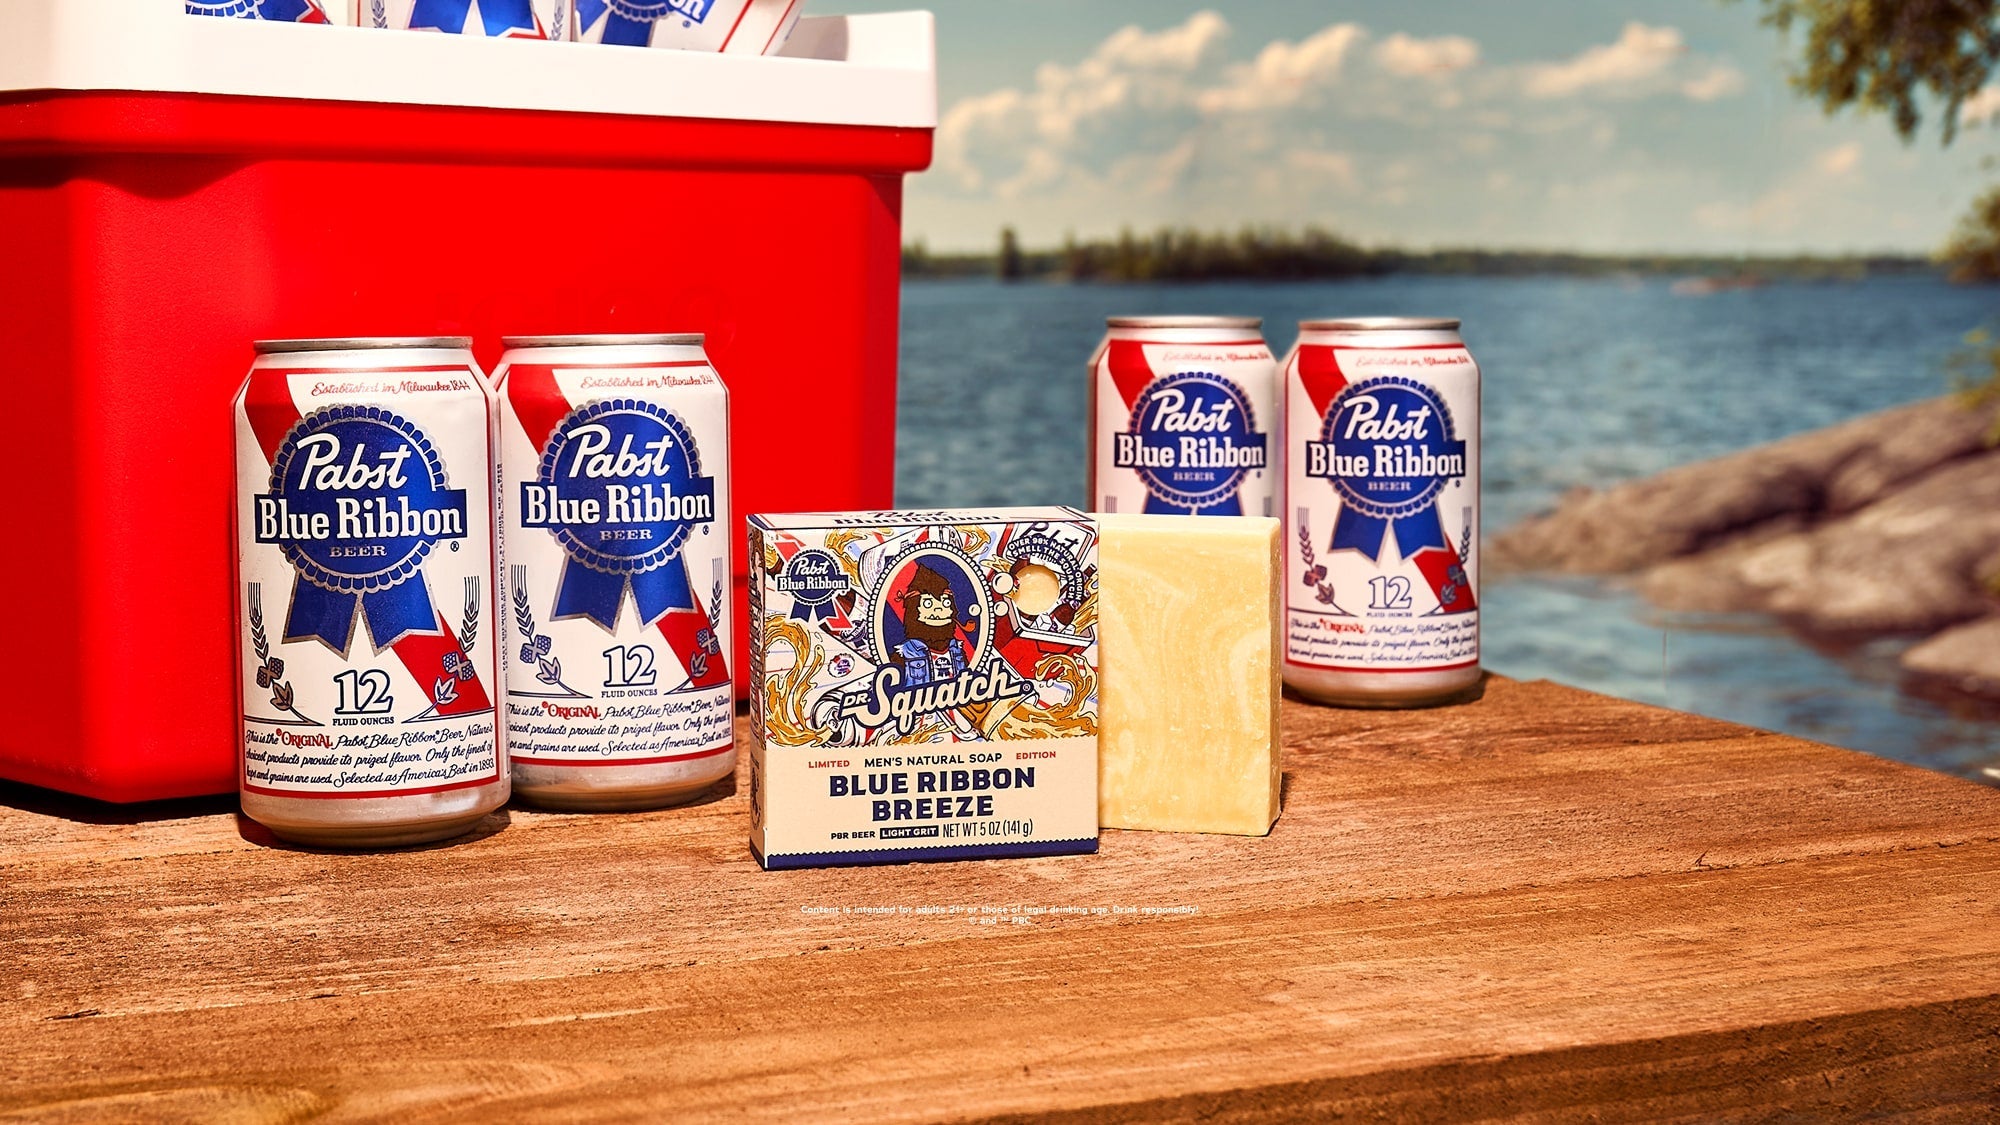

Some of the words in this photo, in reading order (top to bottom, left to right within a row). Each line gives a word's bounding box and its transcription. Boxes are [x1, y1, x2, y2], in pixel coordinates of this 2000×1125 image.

[312, 382, 378, 396] Established
[382, 382, 395, 394] in
[395, 380, 450, 394] Milwaukee
[450, 380, 471, 391] 1844
[580, 377, 644, 388] Established
[646, 378, 659, 388] in
[1150, 388, 1235, 432] Pabst
[1343, 395, 1431, 440] Pabst
[296, 432, 412, 491] Pabst
[566, 423, 674, 479] Pabst
[1117, 434, 1175, 468] Blue
[1178, 436, 1264, 468] Ribbon
[1309, 443, 1370, 477] Blue
[1373, 444, 1464, 478] Ribbon
[525, 484, 600, 524] Blue
[606, 483, 712, 524] Ribbon
[258, 497, 330, 540] Blue
[336, 496, 463, 540] Ribbon
[600, 529, 653, 541] BEER
[330, 545, 388, 558] BEER
[795, 557, 830, 576] Pabst
[1008, 537, 1030, 551] OVER
[1075, 571, 1084, 601] ORIGIN
[1013, 545, 1042, 557] SMELL
[1044, 547, 1062, 560] THE
[1060, 559, 1074, 600] SQUATCH
[779, 578, 806, 591] Blue
[806, 576, 847, 590] Ribbon
[1368, 576, 1413, 610] 12
[602, 644, 657, 688] 12
[333, 668, 394, 716] 12
[601, 690, 626, 698] FLUID
[627, 688, 658, 698] OUNCES
[842, 692, 872, 708] DR.
[333, 718, 358, 726] FLUID
[360, 716, 394, 726] OUNCES
[506, 702, 520, 716] This
[522, 706, 528, 716] is
[530, 706, 544, 716] the
[548, 704, 602, 720] ORIGINAL
[600, 706, 634, 720] Pabst
[631, 704, 660, 720] Blue
[246, 729, 260, 744] This
[260, 732, 266, 743] is
[265, 732, 280, 745] the
[282, 731, 334, 750] ORIGINAL
[331, 734, 369, 750] Pabst
[365, 734, 398, 749] Blue
[460, 723, 494, 742] Nature's
[509, 722, 530, 733] oicest
[530, 724, 566, 736] products
[568, 724, 606, 738] provide
[607, 724, 619, 735] its
[621, 723, 652, 738] prized
[683, 716, 702, 732] Only
[266, 752, 300, 766] products
[300, 754, 338, 768] provide
[340, 754, 353, 766] its
[353, 753, 389, 769] prized
[388, 752, 422, 768] flavor.
[426, 746, 450, 764] Only
[452, 745, 466, 758] the
[465, 740, 487, 760] finest
[487, 739, 494, 756] of
[517, 740, 534, 750] and
[533, 743, 560, 754] grains
[561, 744, 576, 752] are
[601, 740, 647, 756] Selected
[654, 736, 700, 753] America's
[808, 760, 850, 769] LIMITED
[864, 756, 904, 768] MEN'S
[906, 754, 964, 766] NATURAL
[968, 753, 1002, 764] SOAP
[1016, 750, 1057, 760] EDITION
[256, 768, 270, 780] and
[268, 772, 294, 785] grains
[294, 776, 310, 784] are
[310, 773, 332, 784] used.
[333, 772, 384, 788] Selected
[390, 768, 447, 786] America's
[444, 763, 469, 779] Best
[468, 762, 478, 772] in
[829, 772, 909, 798] BLUE
[917, 767, 1036, 794] RIBBON
[872, 795, 994, 822] BREEZE
[830, 831, 849, 840] PBR
[851, 830, 876, 840] BEER
[882, 828, 912, 838] LIGHT
[912, 826, 938, 836] GRIT
[942, 822, 961, 838] NET
[962, 822, 978, 838] WT
[980, 821, 987, 836] 5
[988, 820, 1001, 836] OZ
[1002, 818, 1021, 836] (141
[1022, 818, 1034, 838] g)
